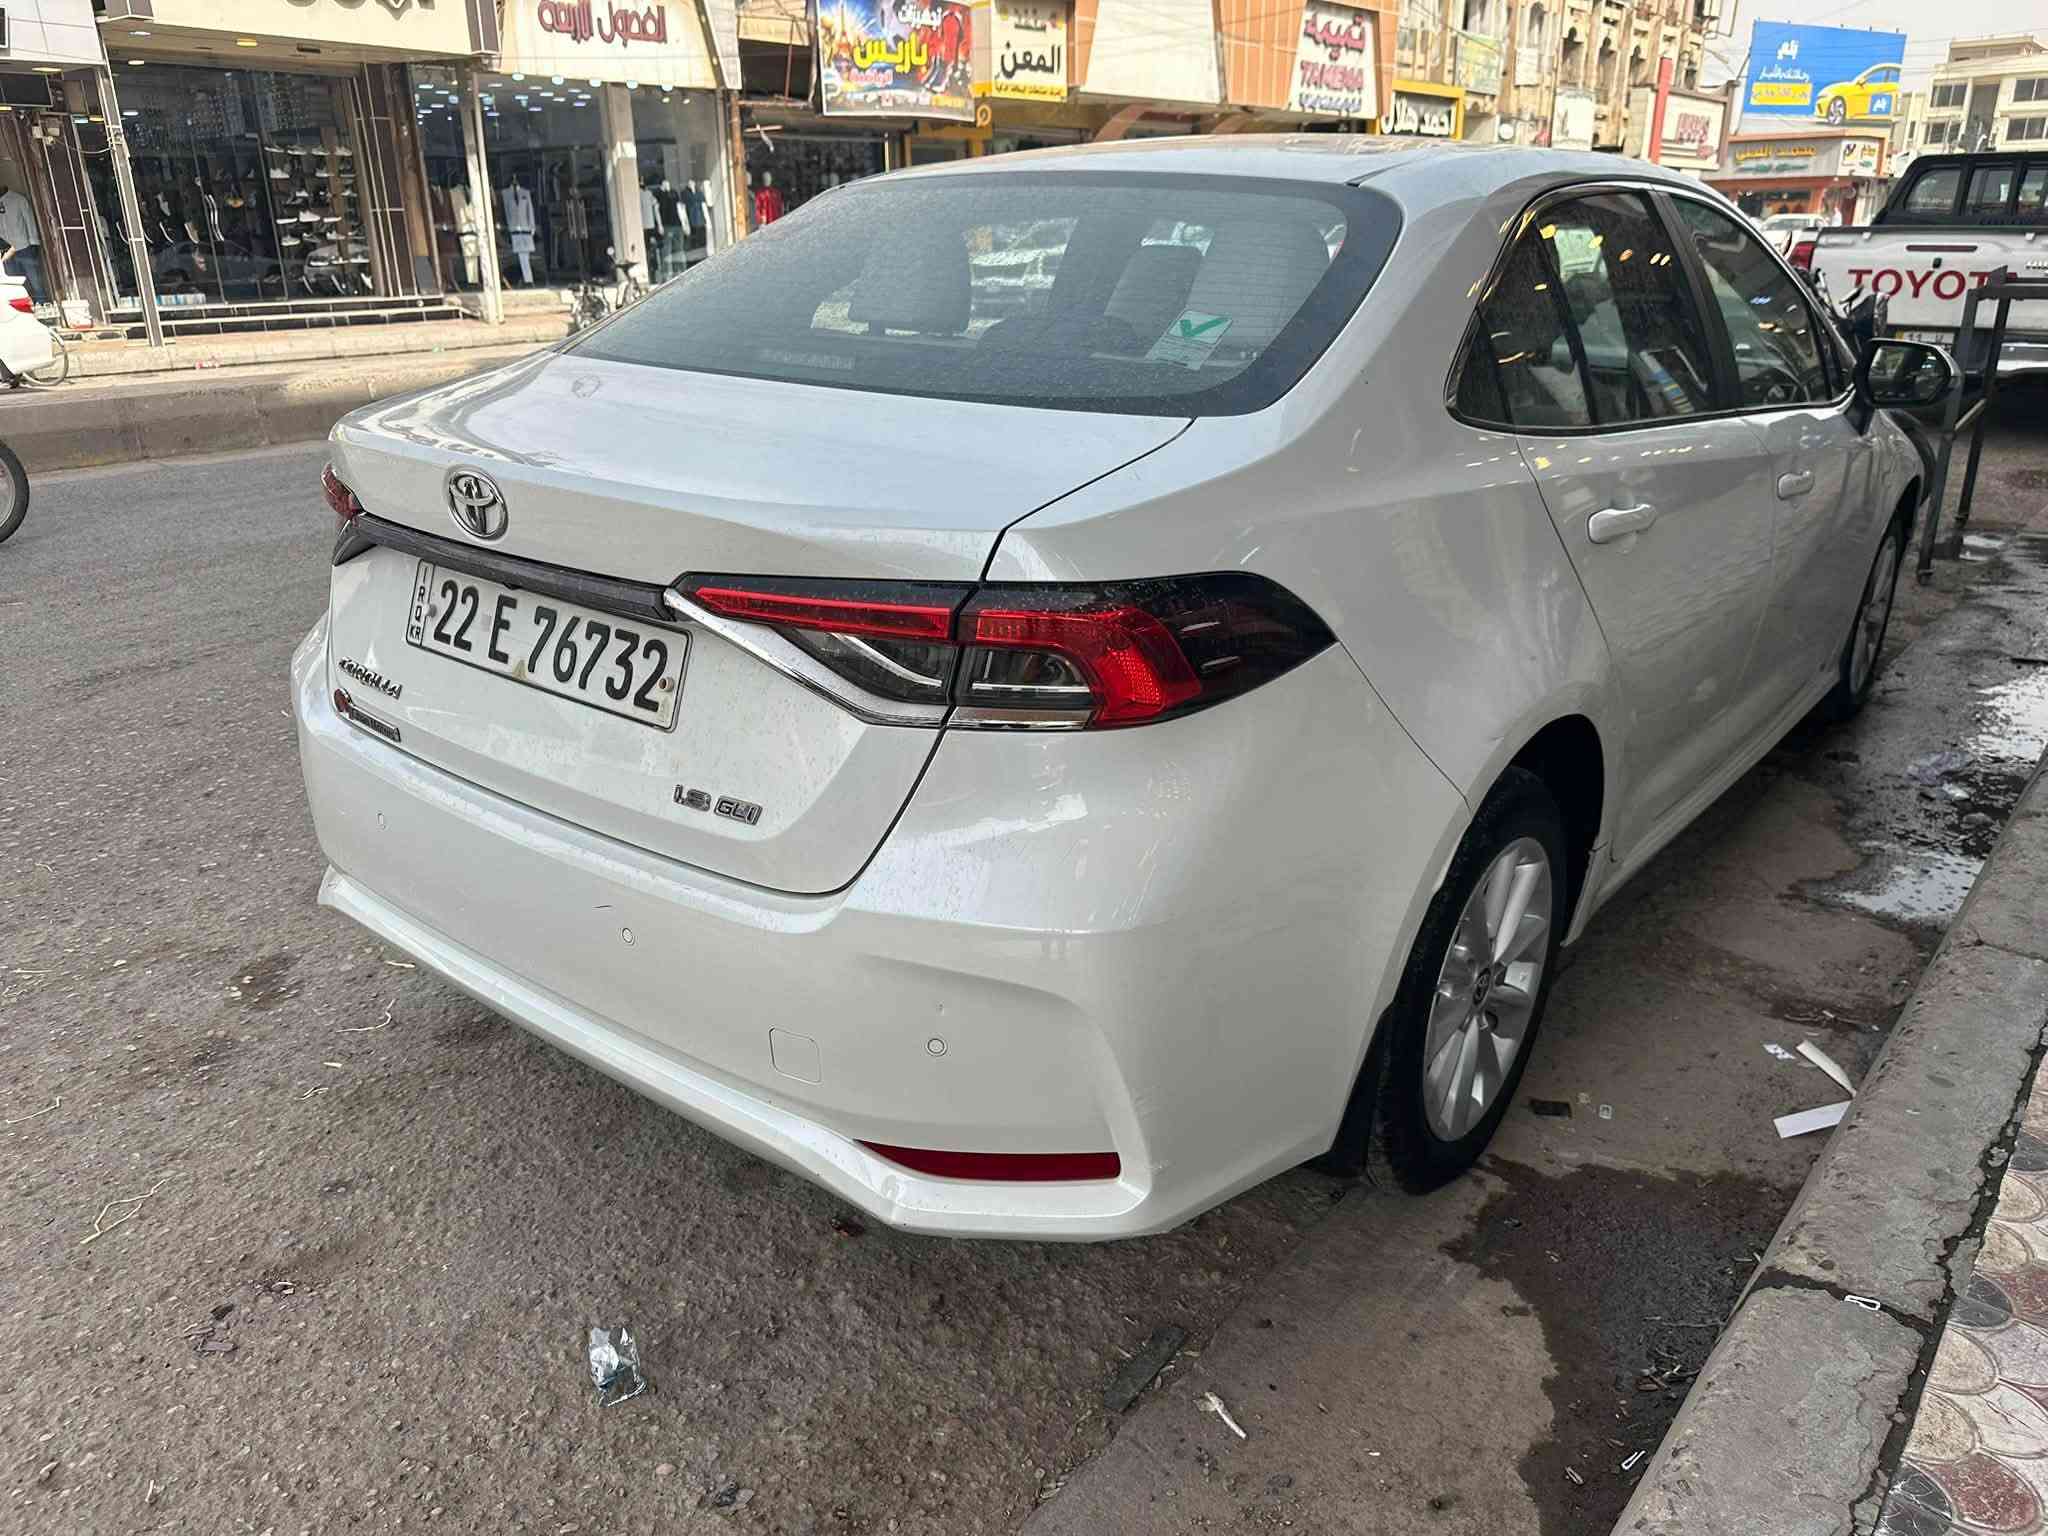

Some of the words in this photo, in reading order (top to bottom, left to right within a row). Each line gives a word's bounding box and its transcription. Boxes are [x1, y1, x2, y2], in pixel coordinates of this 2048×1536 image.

[597, 0, 668, 48] الفصول
[853, 31, 928, 73] باريس
[1848, 268, 2018, 300] TOYOT
[409, 626, 422, 640] KR
[433, 580, 479, 652] 22
[488, 594, 517, 664] E
[527, 605, 668, 713] 76732
